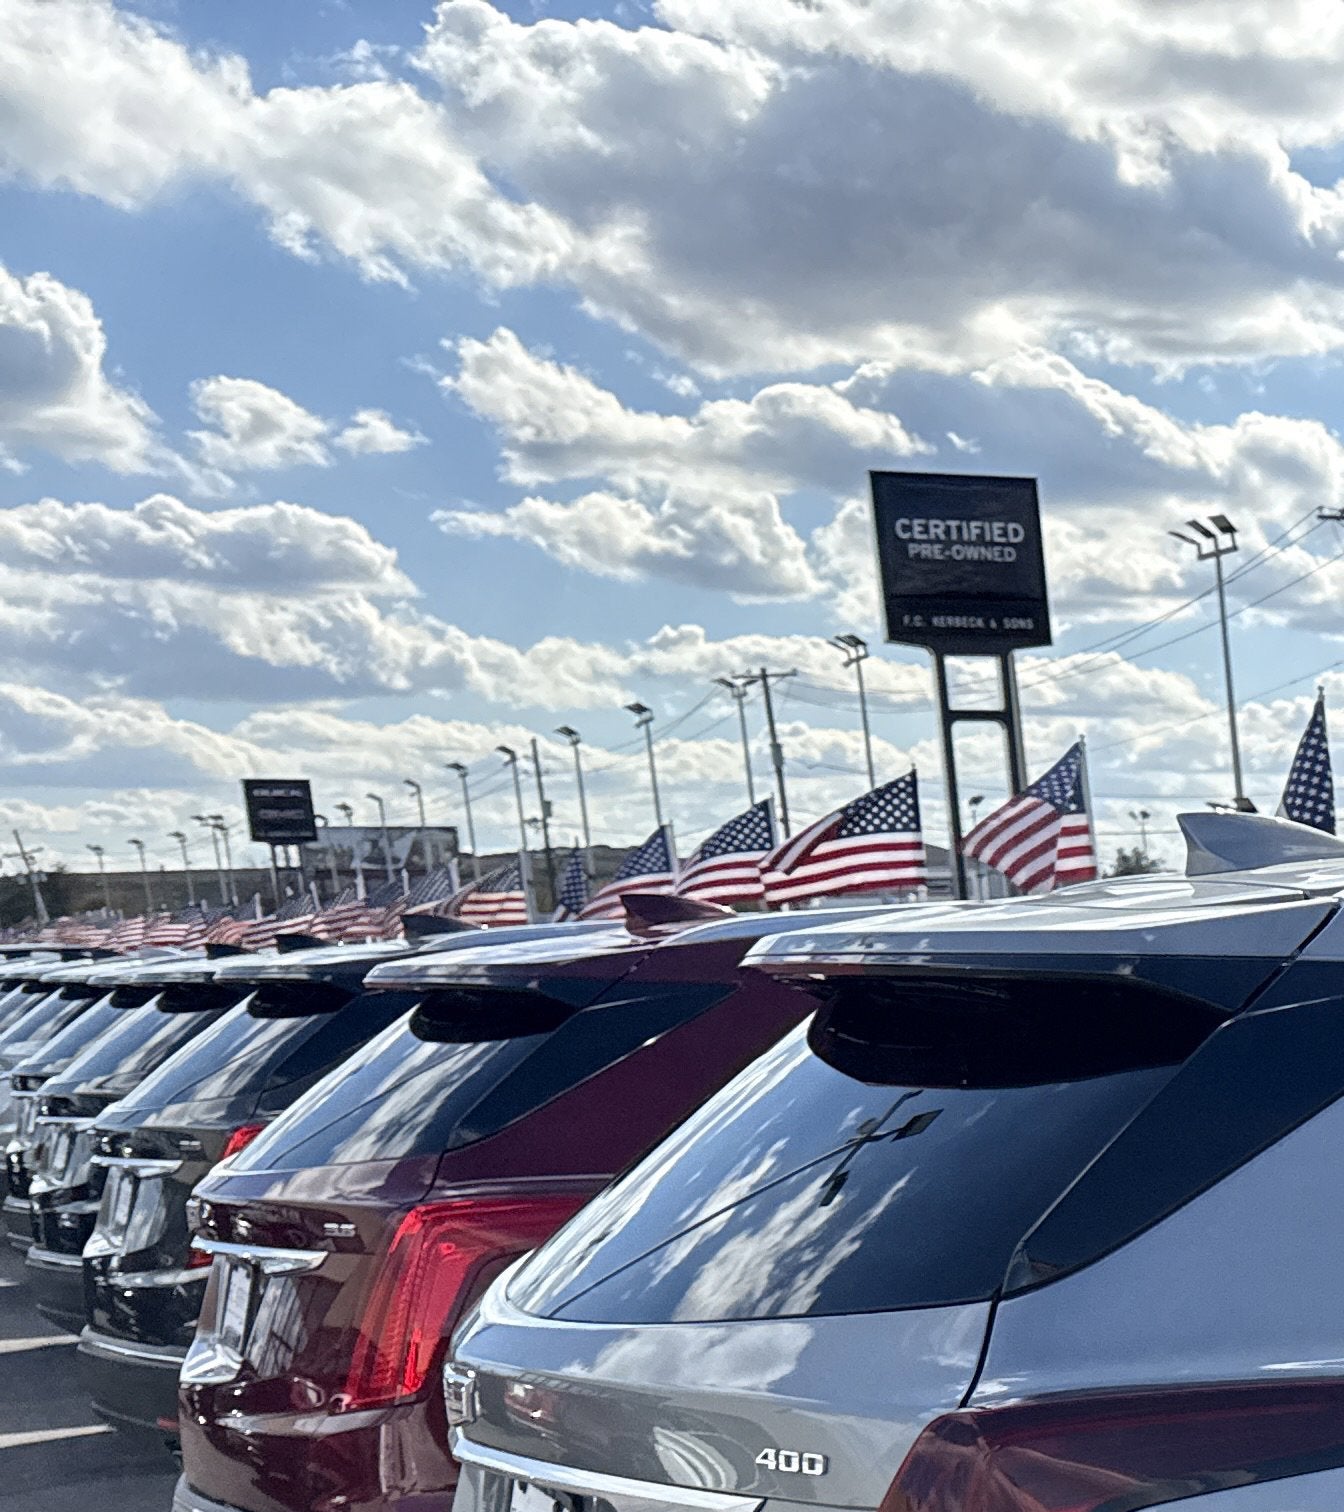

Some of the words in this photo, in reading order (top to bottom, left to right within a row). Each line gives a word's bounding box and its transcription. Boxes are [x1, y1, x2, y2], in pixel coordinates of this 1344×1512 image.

[894, 518, 1025, 543] CERTIFIED
[908, 543, 1017, 562] PRE-OWNED
[931, 615, 985, 628] KERBECK
[1002, 617, 1035, 630] SONS
[755, 1447, 826, 1476] 400
